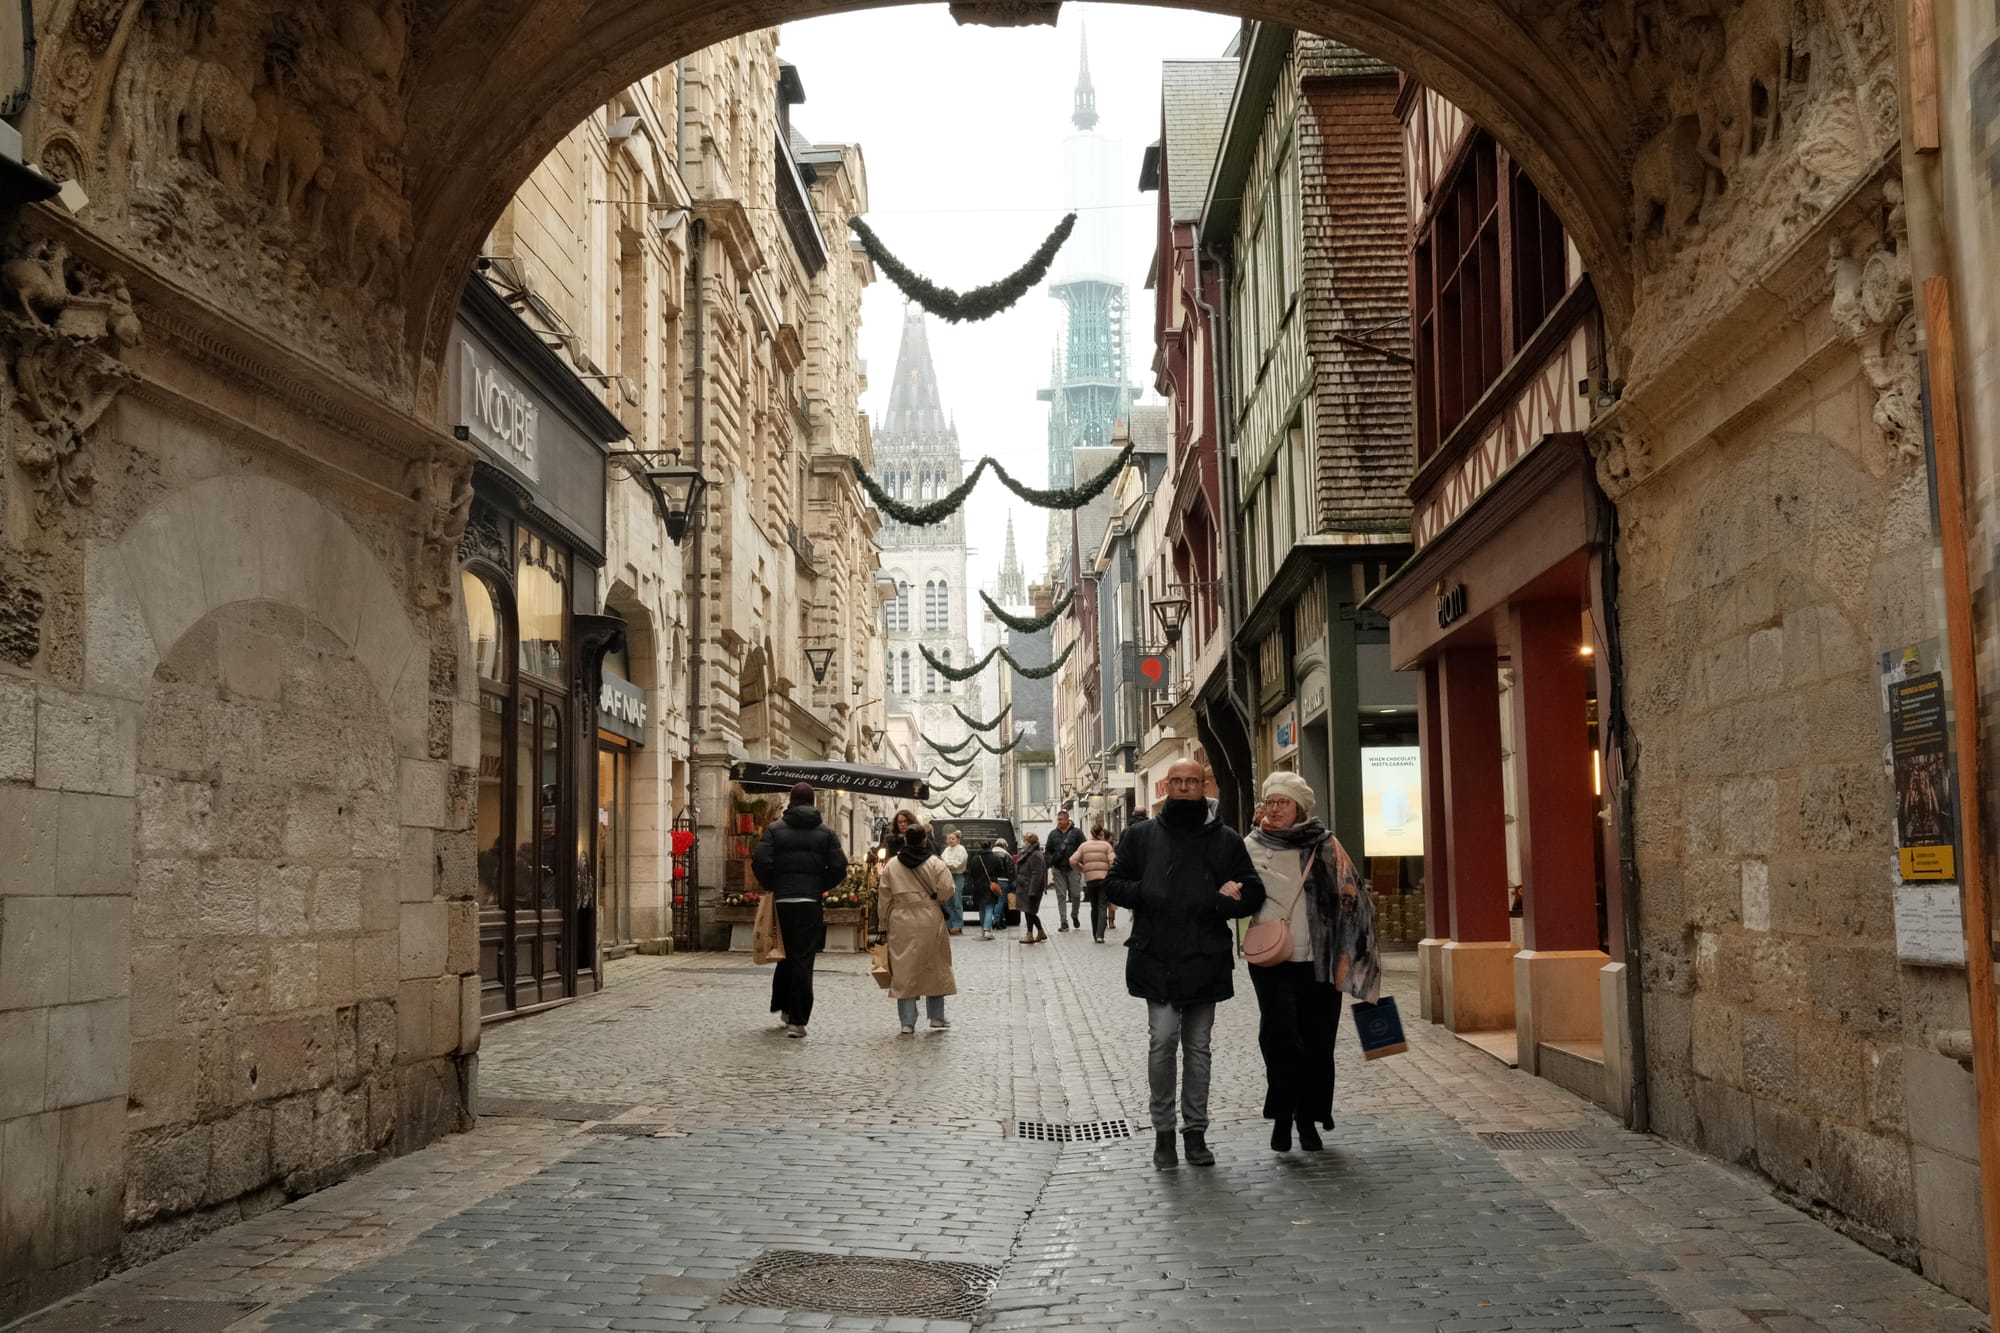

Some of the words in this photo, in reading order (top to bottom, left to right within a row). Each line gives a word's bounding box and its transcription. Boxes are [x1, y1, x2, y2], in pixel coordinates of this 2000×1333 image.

[475, 366, 533, 461] NOCIBÉ
[622, 694, 647, 728] NAF
[760, 763, 819, 781] Livraison
[820, 773, 835, 783] 06
[836, 774, 851, 784] 83
[853, 776, 866, 786] 13
[867, 777, 882, 788] 62
[882, 780, 899, 790] 28
